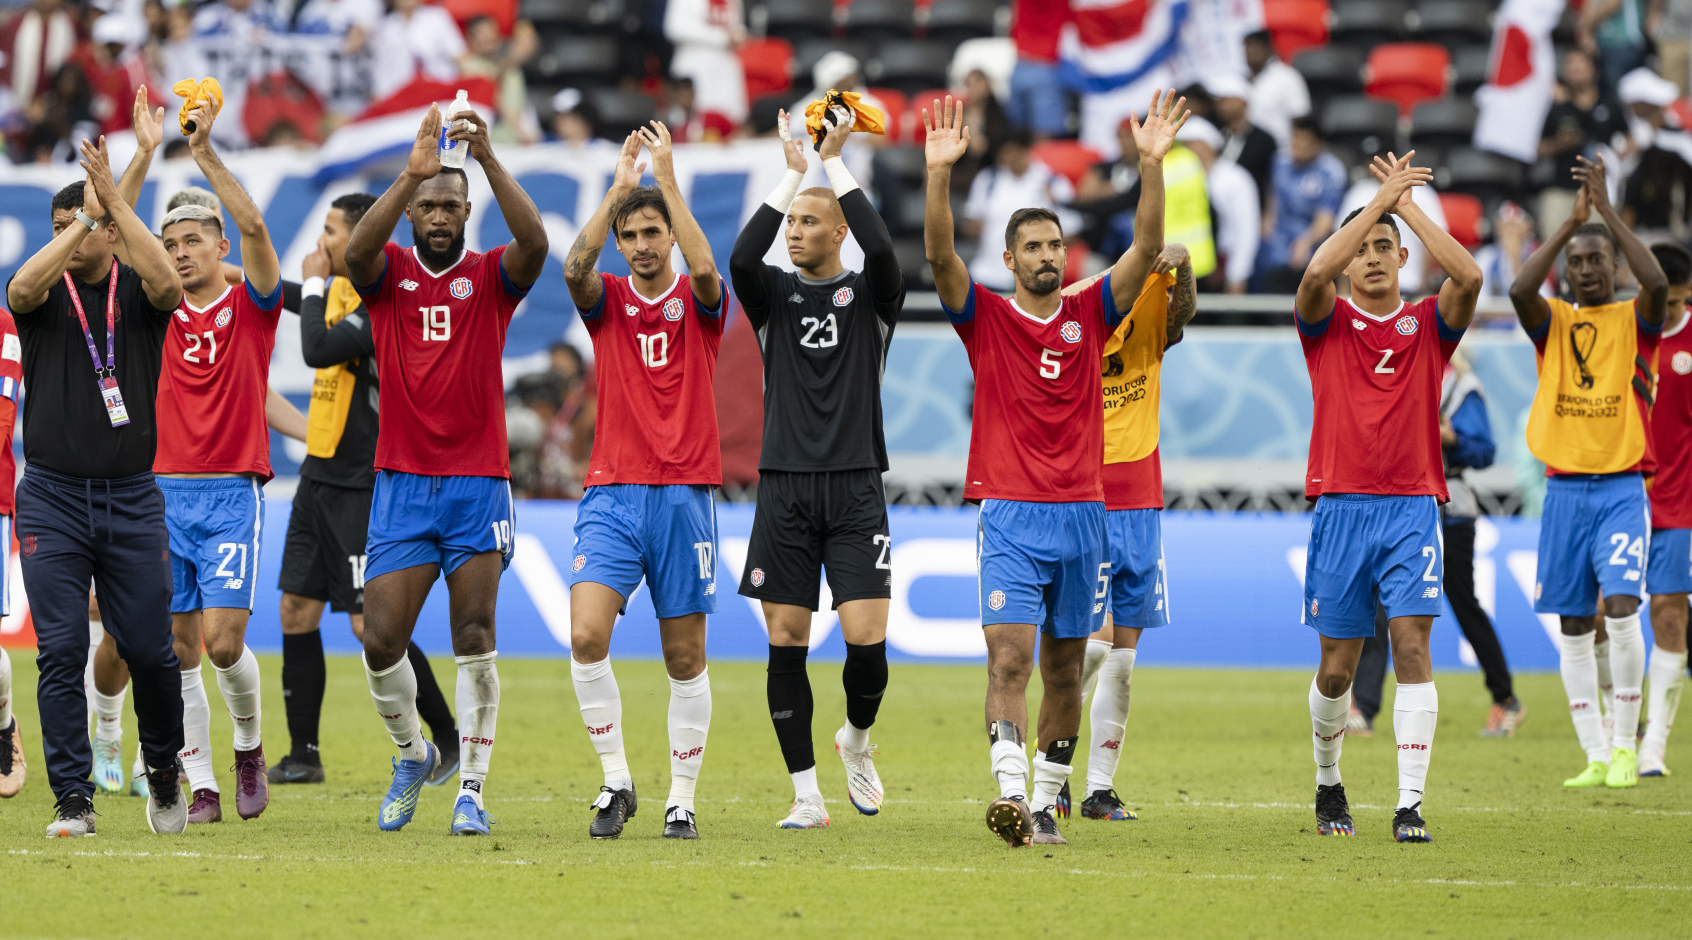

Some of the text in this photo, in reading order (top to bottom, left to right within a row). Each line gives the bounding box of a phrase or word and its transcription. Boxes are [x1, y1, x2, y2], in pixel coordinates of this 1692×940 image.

[418, 305, 451, 341] 19
[800, 313, 838, 348] 23
[183, 330, 217, 364] 21
[636, 332, 668, 368] 10
[1039, 348, 1063, 380] 5
[1374, 349, 1395, 374] 2
[1103, 382, 1131, 396] ORLD
[1103, 388, 1146, 409] ar2022
[491, 520, 510, 553] 19
[1609, 532, 1644, 569] 24
[215, 542, 247, 579] 21
[1422, 546, 1438, 582] 2
[1095, 562, 1111, 599] 5
[462, 736, 493, 746] FCRF
[673, 746, 703, 760] FCRF
